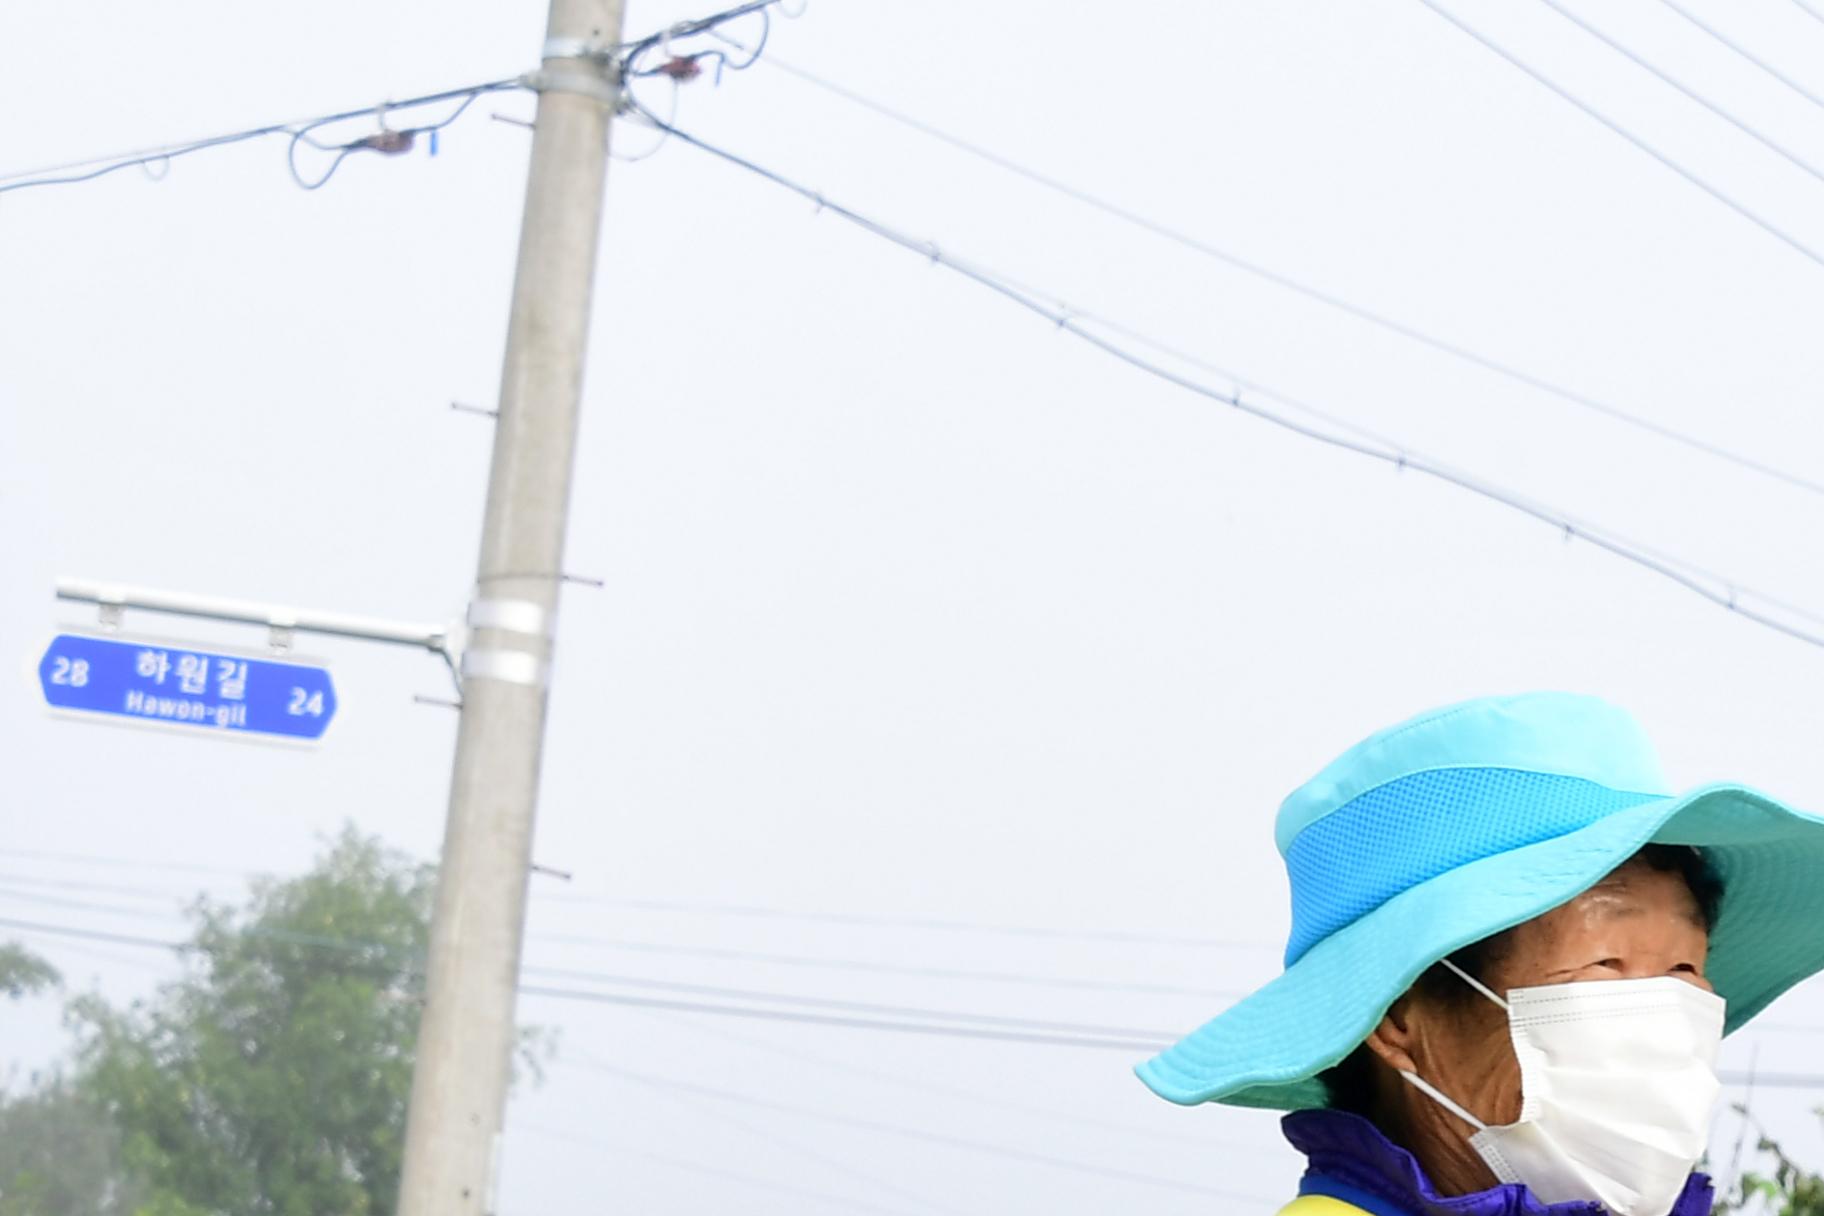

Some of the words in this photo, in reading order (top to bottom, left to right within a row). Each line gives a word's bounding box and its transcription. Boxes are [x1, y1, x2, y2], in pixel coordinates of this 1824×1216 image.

[52, 657, 89, 686] 28
[137, 650, 247, 699] 하원길
[127, 691, 246, 727] Hawon-gil
[289, 687, 323, 716] 24
